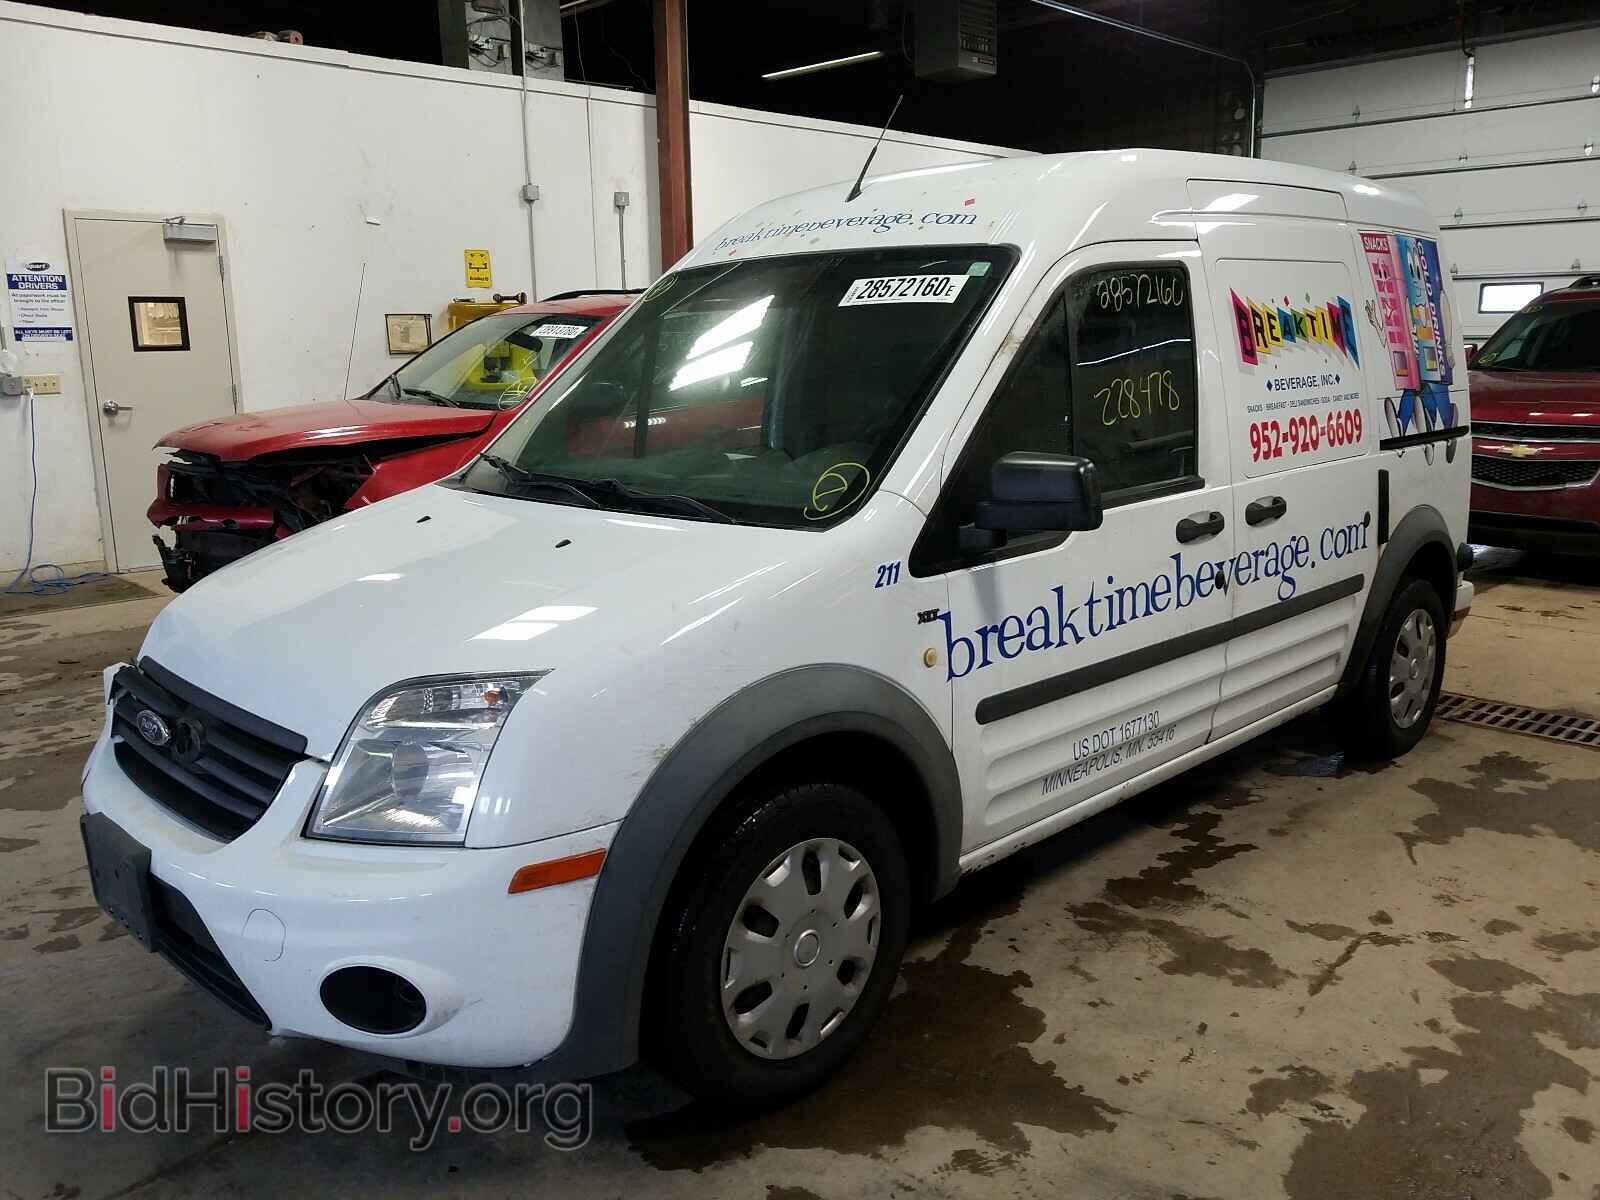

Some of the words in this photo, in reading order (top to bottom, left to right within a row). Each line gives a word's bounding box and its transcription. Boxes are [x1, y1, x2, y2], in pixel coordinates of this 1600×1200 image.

[1363, 236, 1389, 252] SNACKS
[12, 274, 63, 283] ATTENTION
[18, 282, 59, 290] DRIVERS
[1417, 241, 1433, 296] COLD
[1429, 303, 1447, 377] DRINKS
[1232, 292, 1358, 366] BREAKTIME
[1320, 373, 1336, 387] INC.
[1249, 408, 1363, 463] 952-920-6609
[875, 561, 902, 589] 211
[937, 519, 1369, 684] breaktimebeverage.com
[1073, 738, 1090, 761] US
[1092, 726, 1117, 754] DOT
[1120, 710, 1160, 741] 1677130
[1147, 724, 1177, 750] 55416
